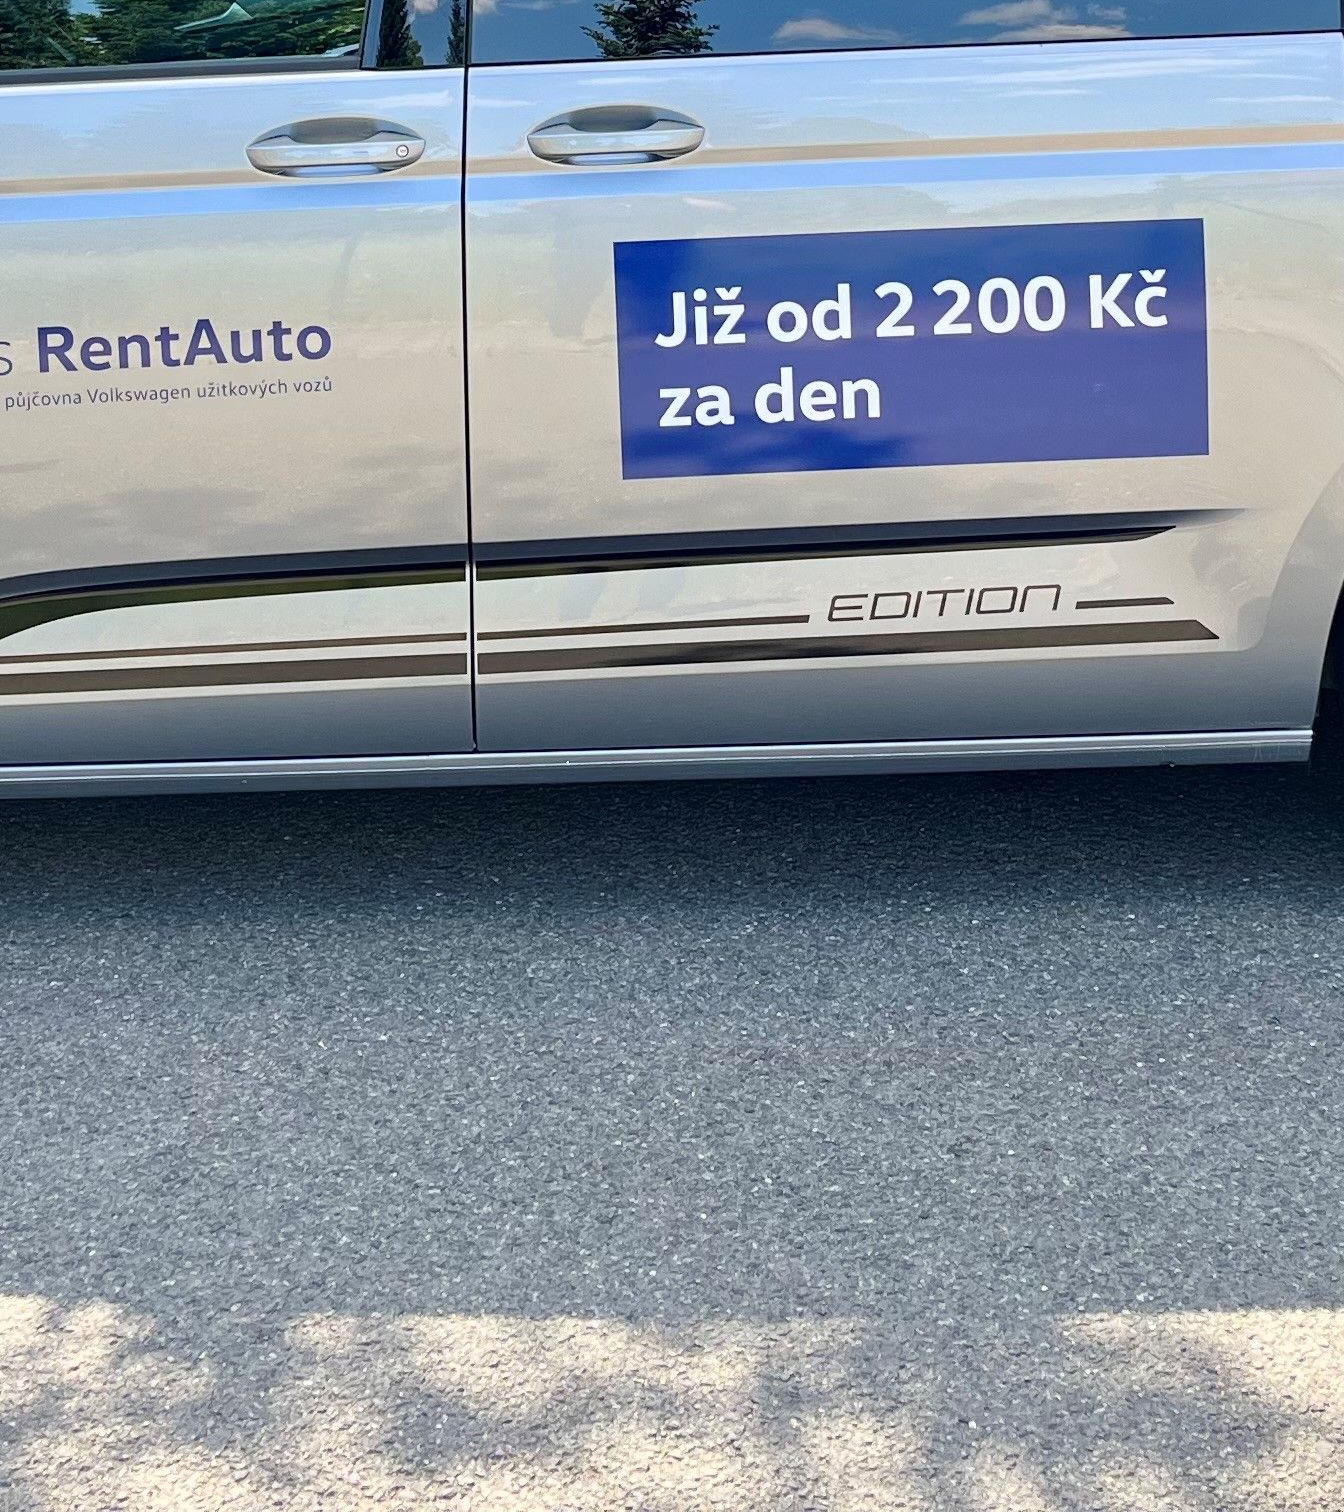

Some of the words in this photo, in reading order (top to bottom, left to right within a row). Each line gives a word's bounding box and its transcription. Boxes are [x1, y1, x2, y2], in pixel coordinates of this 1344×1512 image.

[654, 285, 746, 347] Již
[767, 283, 852, 343] od
[1089, 268, 1168, 329] Kč
[37, 318, 332, 373] RentAuto
[5, 389, 83, 412] půjčovna
[87, 385, 191, 408] Volkswagen
[197, 379, 288, 399] užitkových
[293, 374, 333, 394] vozů
[658, 383, 735, 428] za
[754, 366, 881, 424] den
[827, 584, 1062, 622] EDITION
